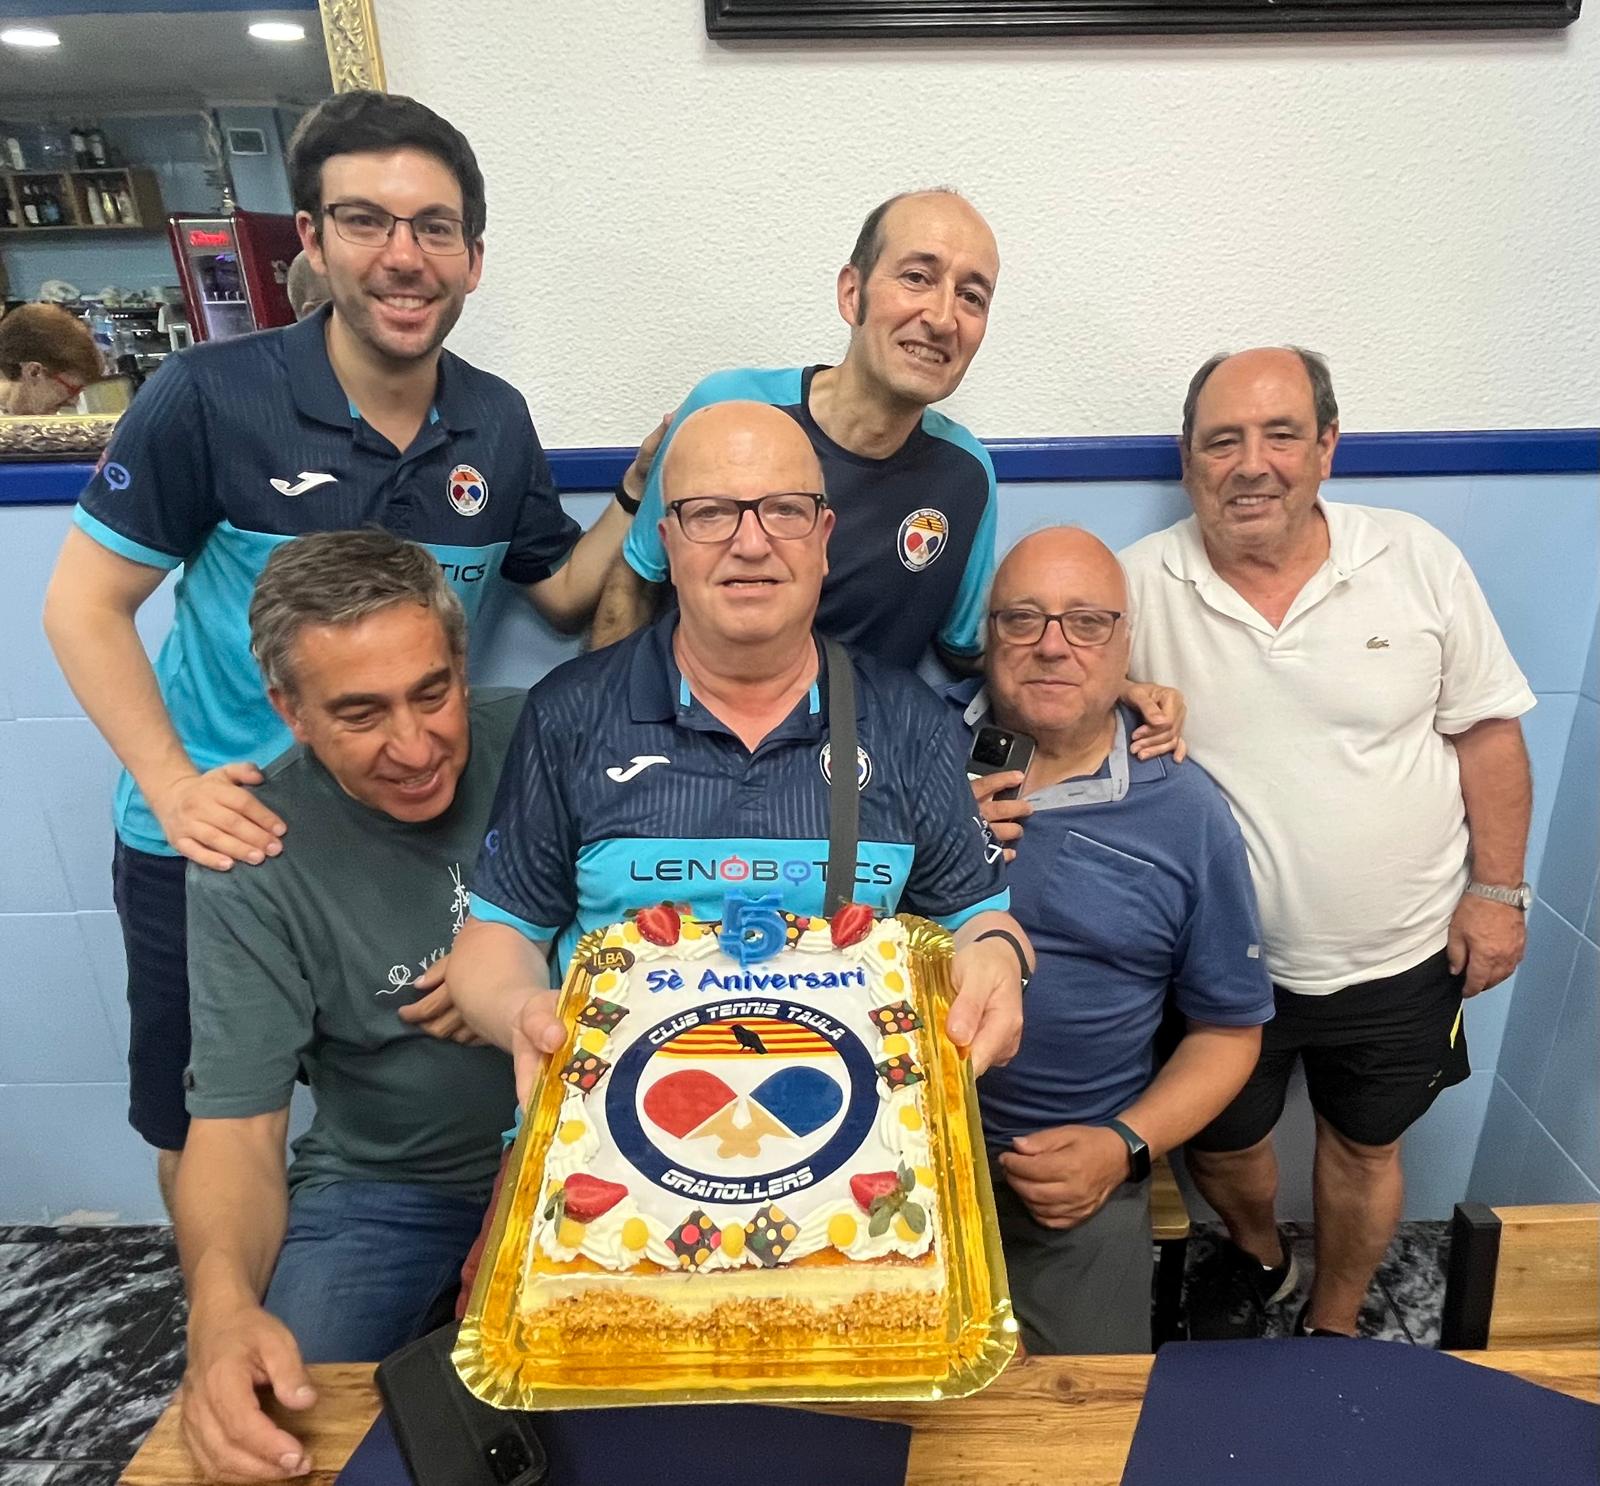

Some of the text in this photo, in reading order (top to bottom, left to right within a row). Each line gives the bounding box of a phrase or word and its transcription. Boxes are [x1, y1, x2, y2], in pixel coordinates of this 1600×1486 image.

[630, 857, 892, 885] LENOBOTCS
[718, 888, 787, 968] 5
[645, 966, 866, 993] 5è Aniversari
[648, 1002, 847, 1045] CLUB TENNIS TAULA
[660, 1165, 814, 1200] GRANOLLERS
